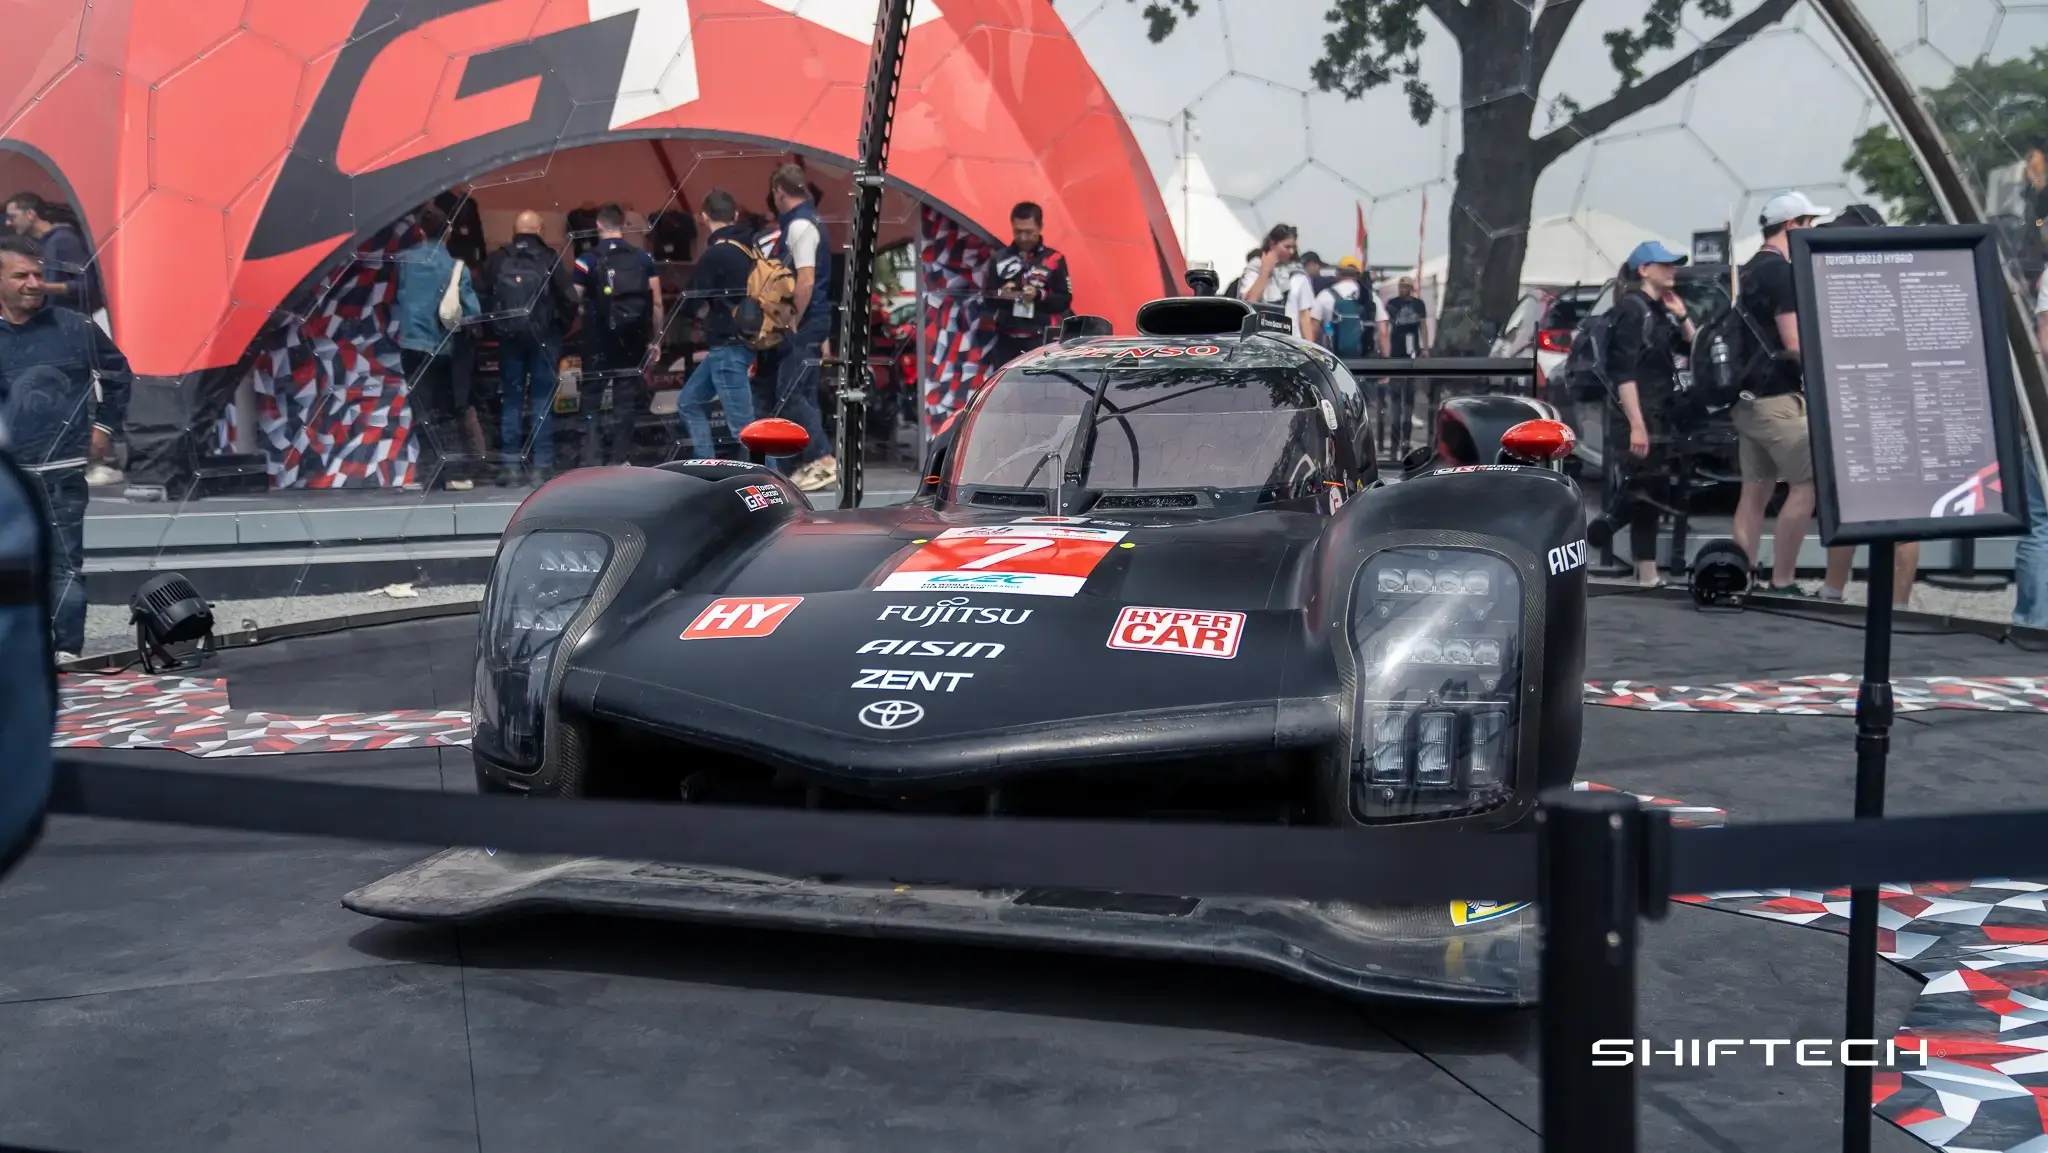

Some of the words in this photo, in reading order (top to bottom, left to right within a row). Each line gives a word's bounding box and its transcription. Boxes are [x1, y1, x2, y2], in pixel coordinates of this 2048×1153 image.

[745, 494, 767, 508] GR
[957, 539, 1056, 569] 7
[1548, 538, 1587, 575] AISIN
[928, 574, 1036, 583] WEC
[693, 603, 792, 630] HY
[876, 597, 1034, 627] FUJITSU
[1128, 610, 1232, 628] HYPER
[855, 639, 1005, 659] AISIN
[1121, 622, 1228, 651] CAR
[850, 668, 974, 692] ZENT
